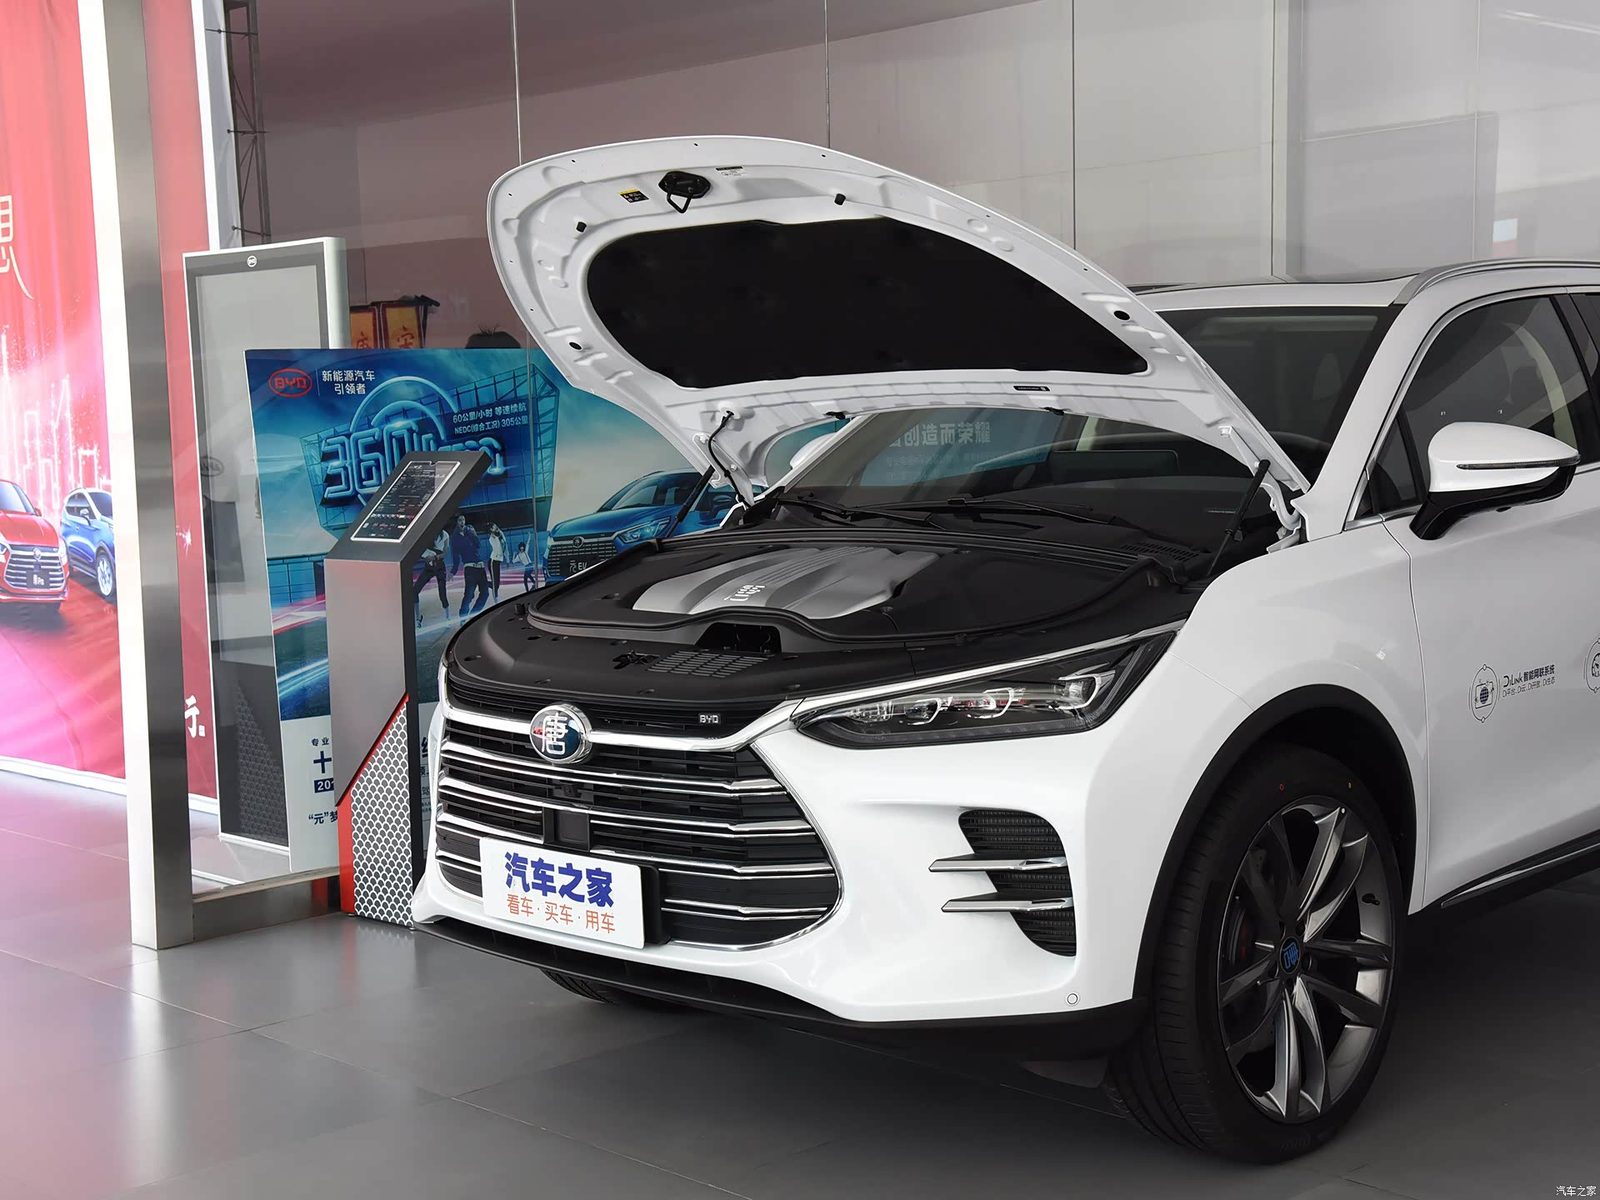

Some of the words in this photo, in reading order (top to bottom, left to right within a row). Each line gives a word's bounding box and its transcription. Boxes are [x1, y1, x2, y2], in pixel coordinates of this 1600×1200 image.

[321, 370, 376, 382] 新能源汽车
[274, 377, 308, 390] BYD
[334, 383, 366, 395] 引领者
[501, 415, 529, 428] 305公里
[699, 714, 720, 724] BYD
[504, 851, 614, 908] 汽车之家
